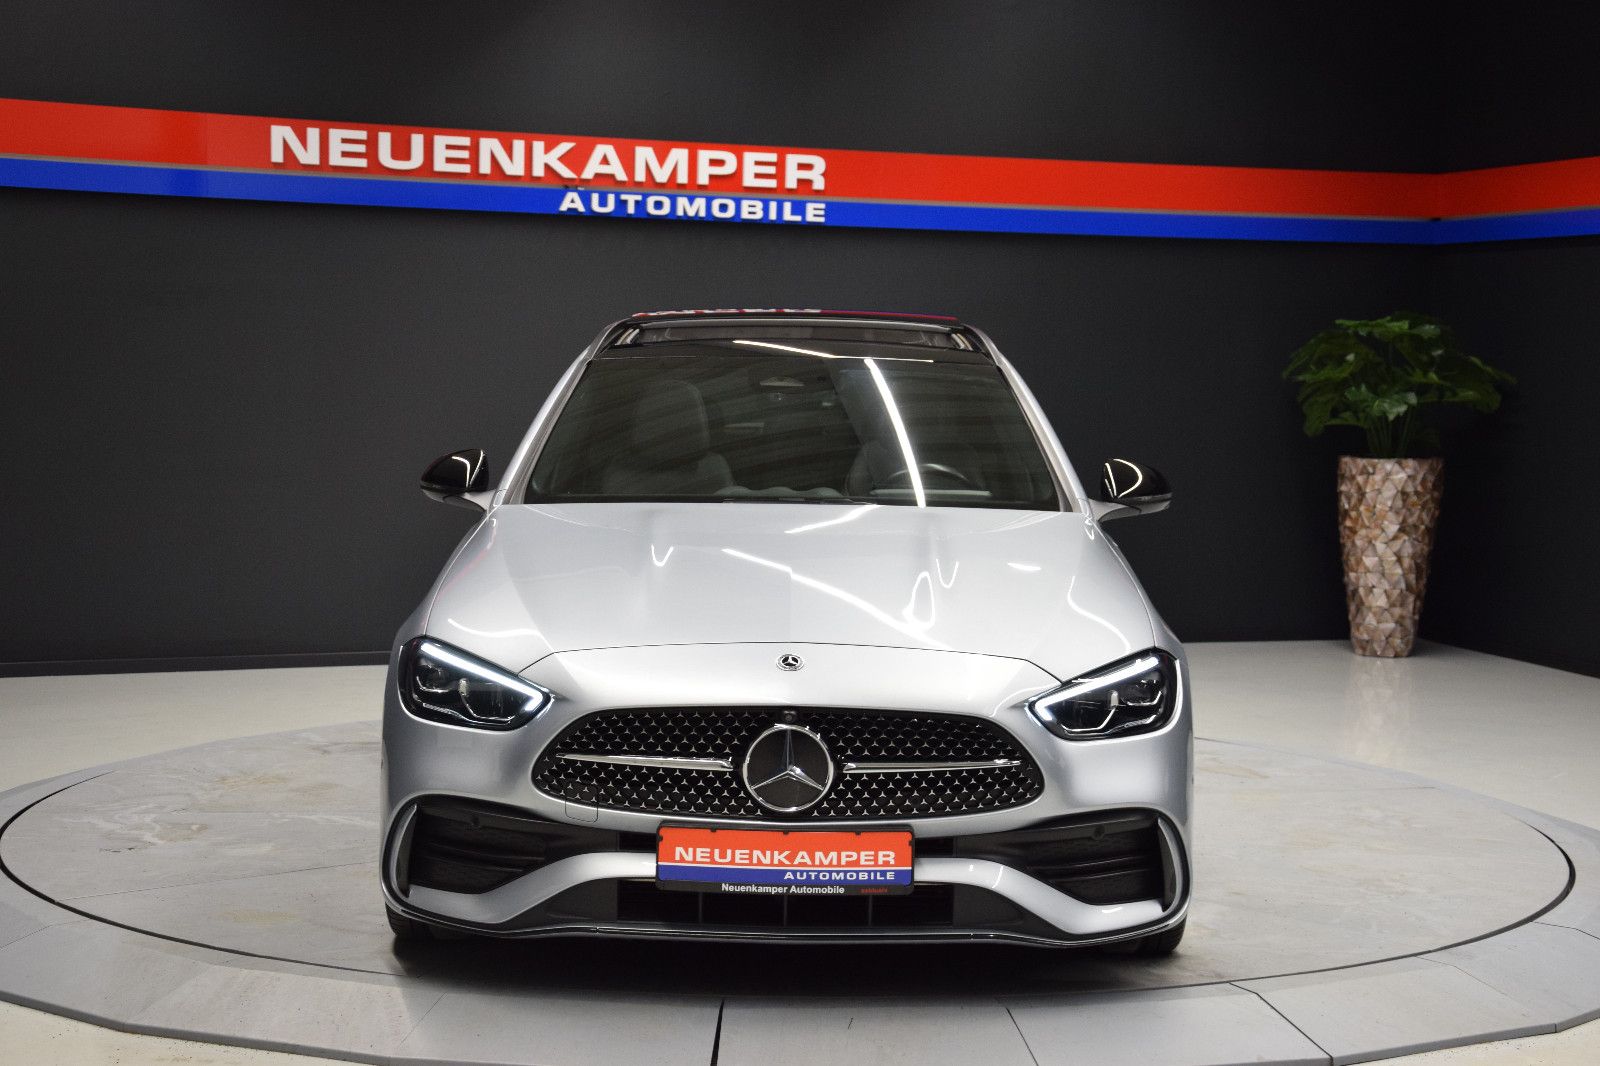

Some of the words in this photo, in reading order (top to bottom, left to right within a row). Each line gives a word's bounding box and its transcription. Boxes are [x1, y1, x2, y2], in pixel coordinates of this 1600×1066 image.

[270, 124, 826, 191] NEUENKAMPER
[559, 191, 826, 223] AUTOMOBILE
[674, 846, 896, 866] NEUENKAMPER
[783, 870, 896, 881] AUTOMOBILE
[721, 882, 788, 895] Neuenkamper
[789, 885, 845, 894] Automobile
